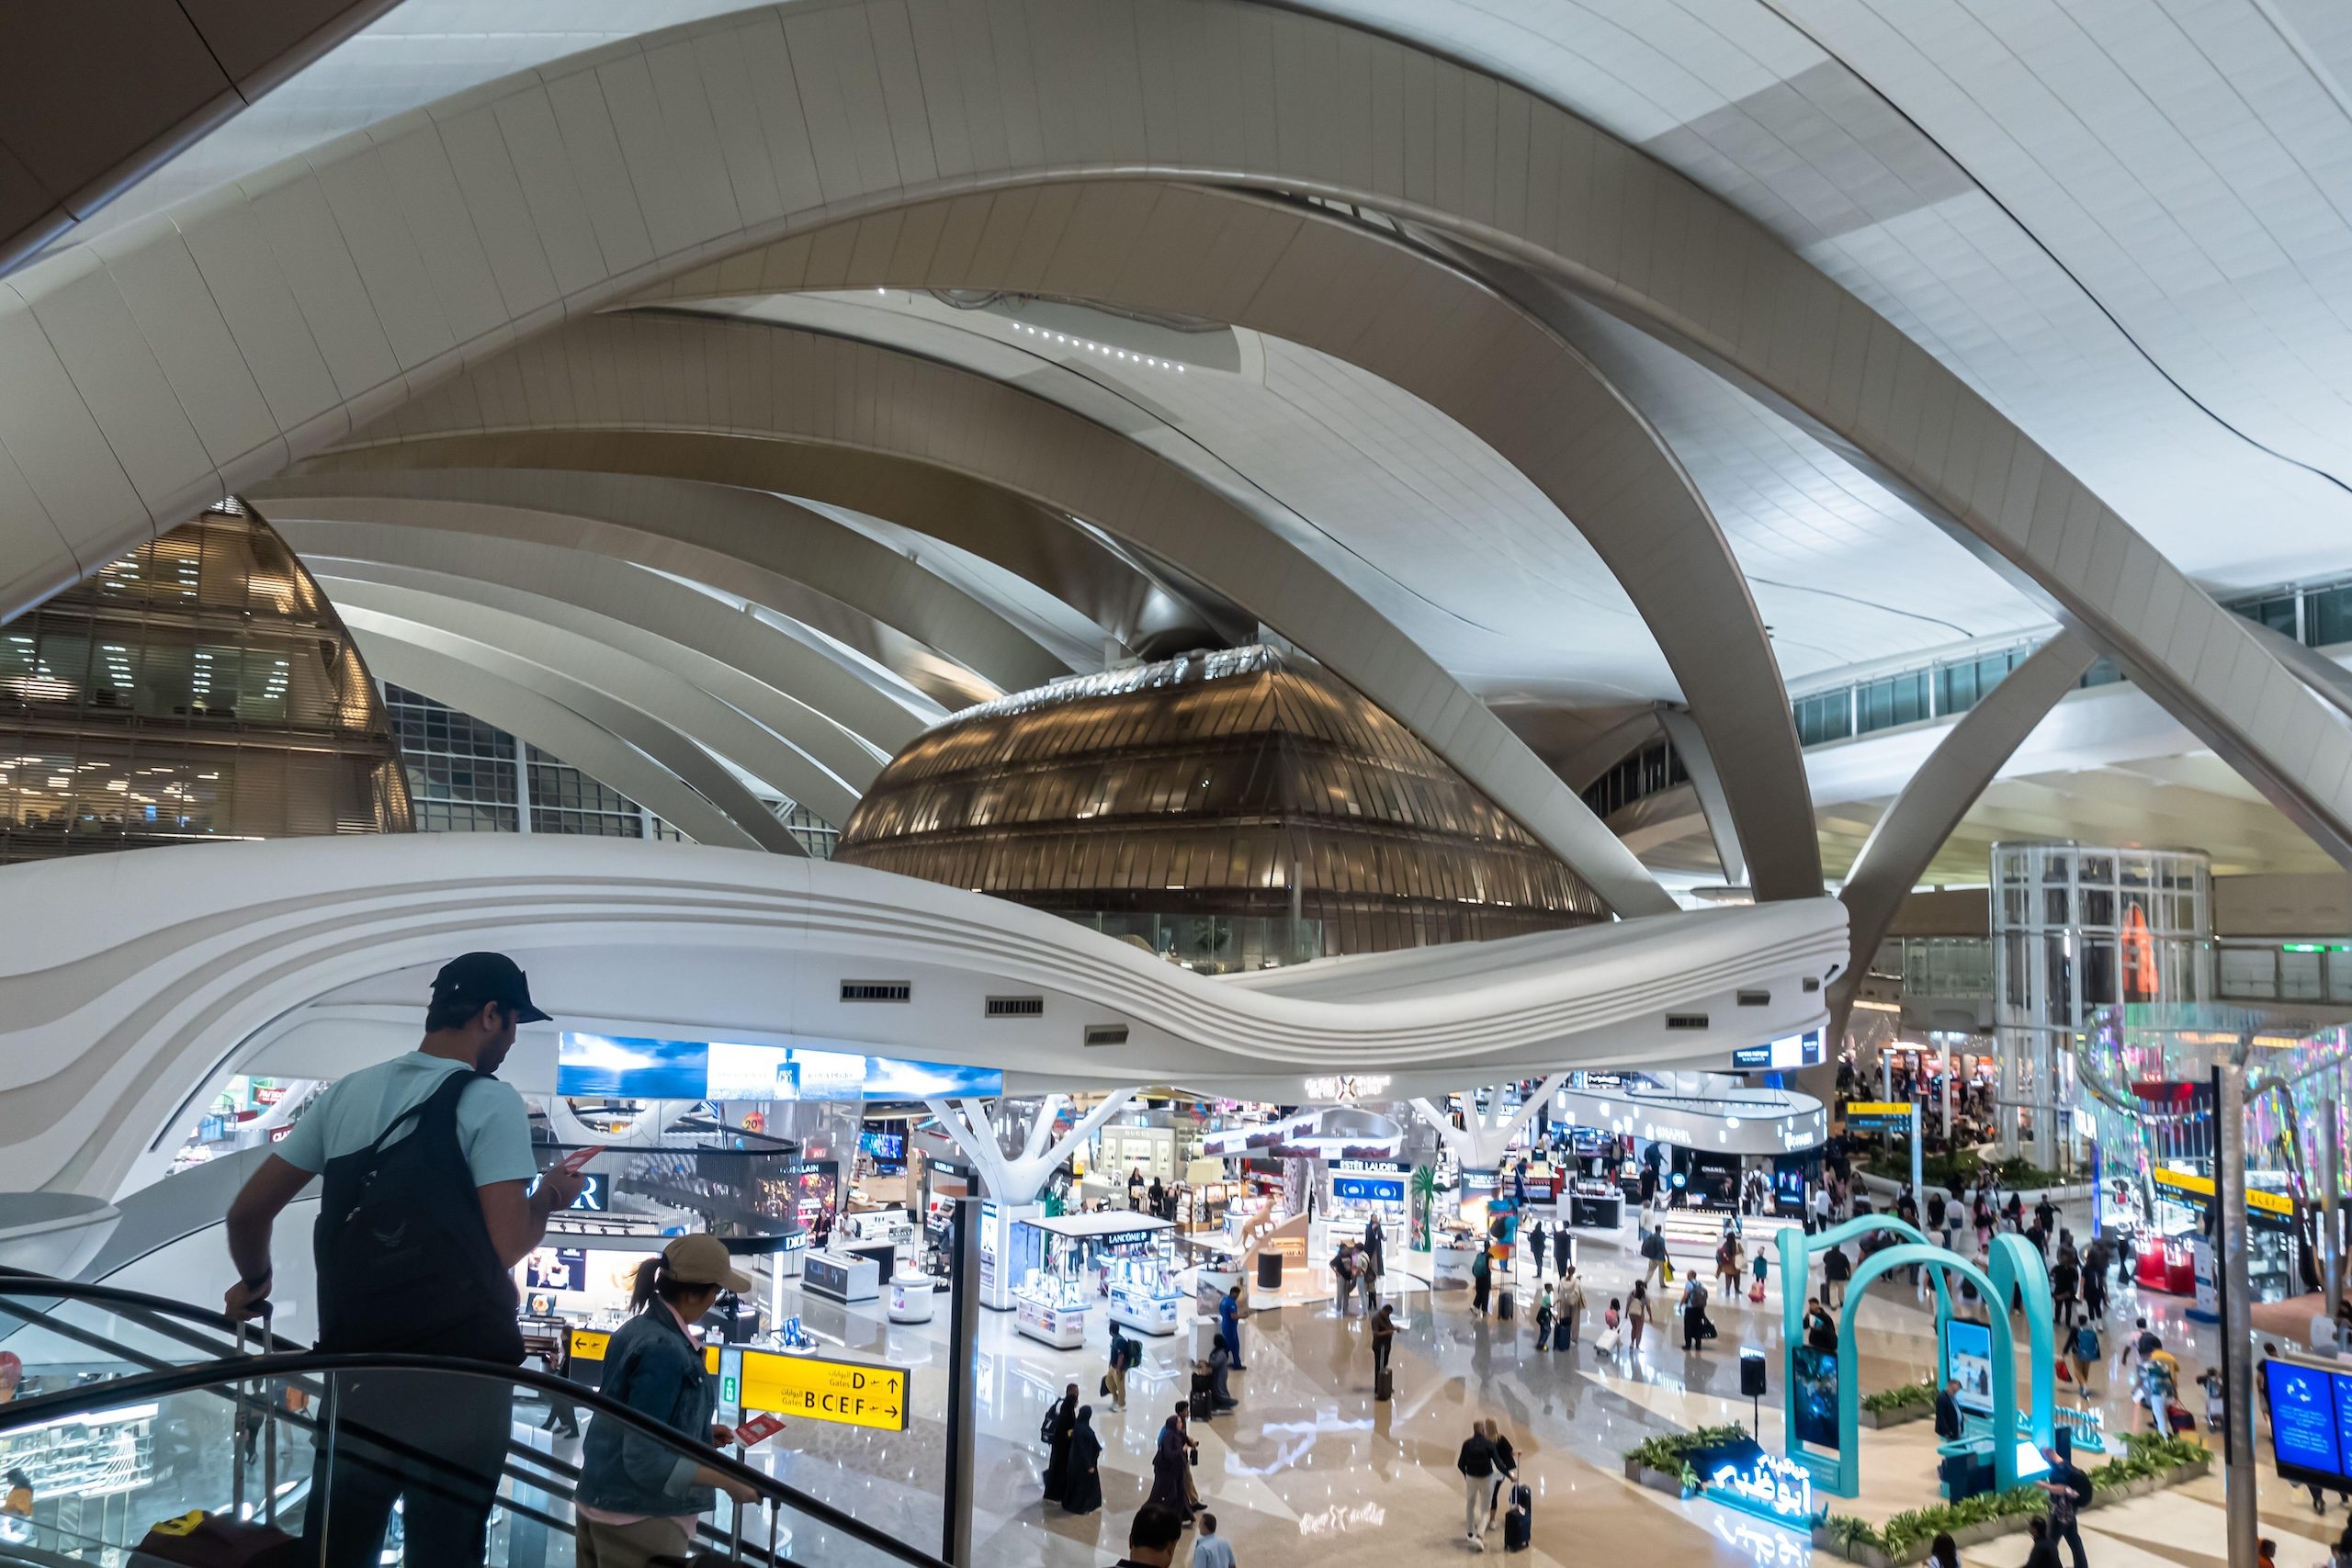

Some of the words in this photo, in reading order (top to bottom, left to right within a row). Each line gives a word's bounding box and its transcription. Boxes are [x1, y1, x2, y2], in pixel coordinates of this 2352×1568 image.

[745, 1120, 758, 1129] 20
[829, 1379, 850, 1388] Gates
[853, 1372, 865, 1389] D
[782, 1397, 802, 1407] Gates
[805, 1392, 815, 1408] B
[822, 1394, 833, 1411] C
[840, 1396, 849, 1414] E
[856, 1398, 865, 1416] F
